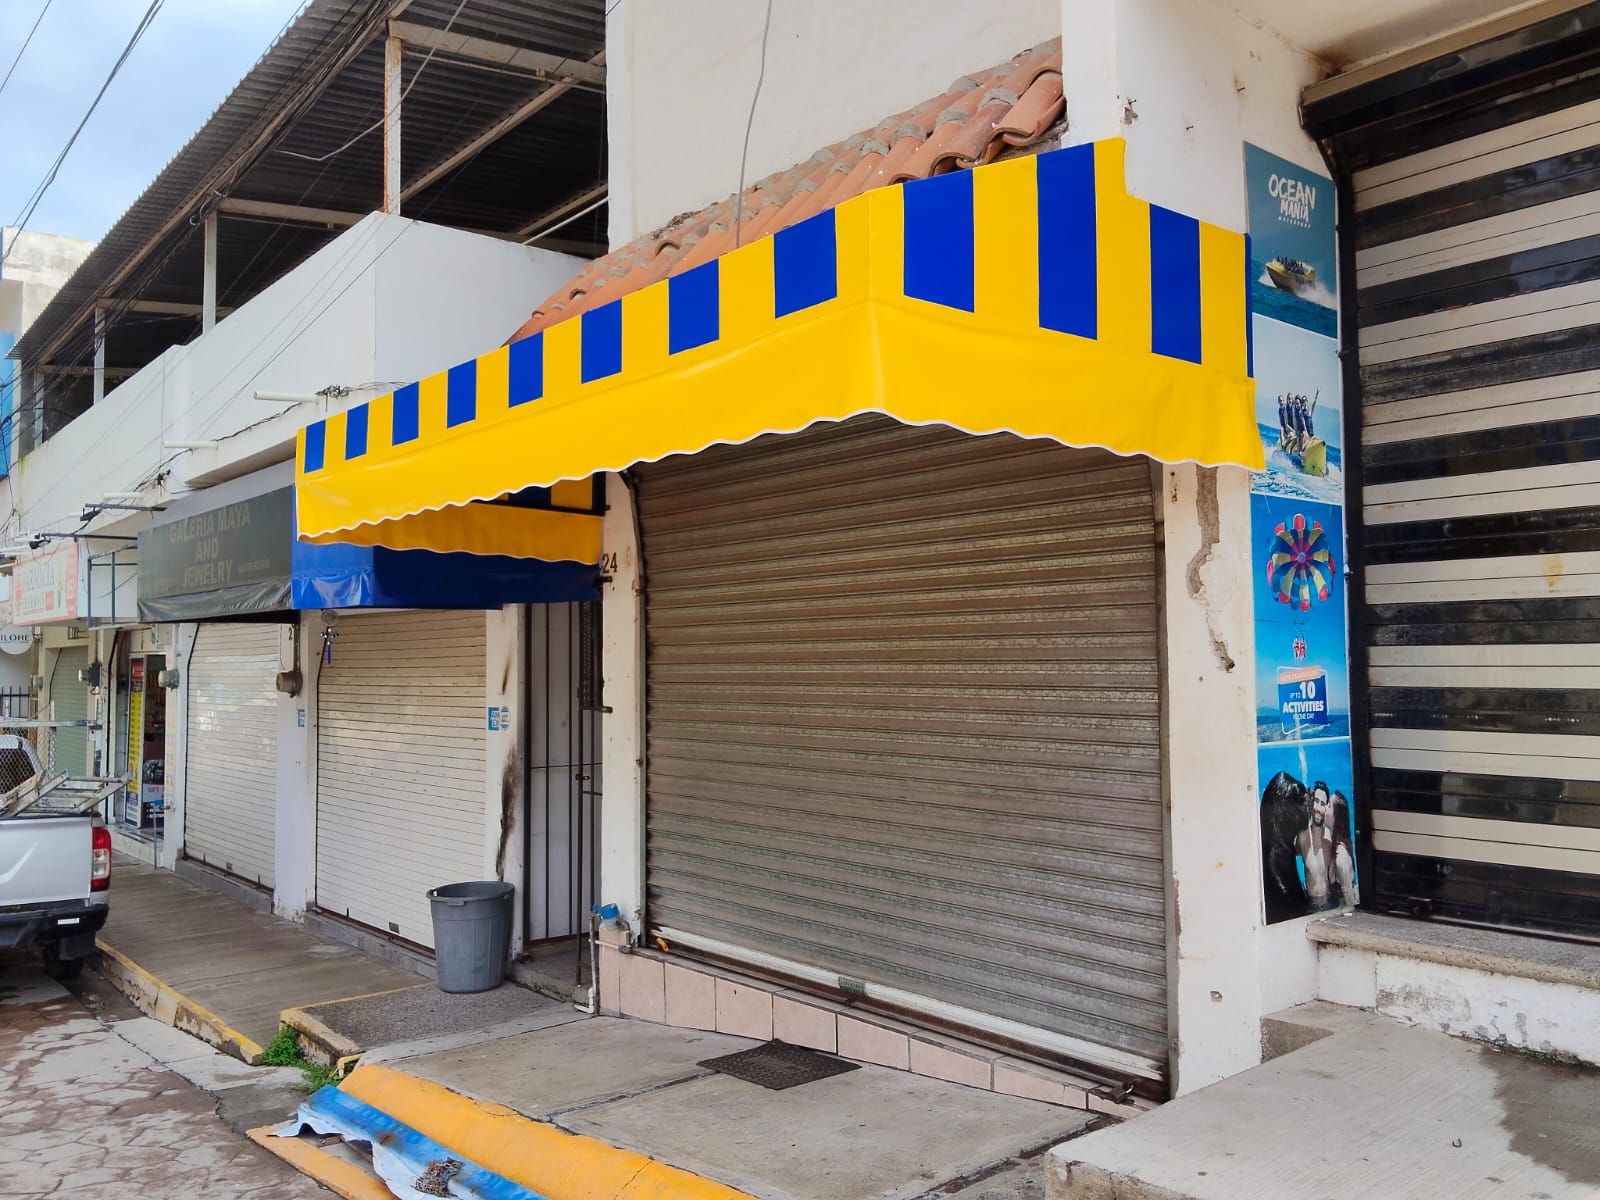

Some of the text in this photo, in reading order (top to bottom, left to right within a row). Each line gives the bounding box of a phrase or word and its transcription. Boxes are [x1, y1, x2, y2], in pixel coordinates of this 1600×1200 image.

[1269, 174, 1315, 209] OCEAN
[217, 503, 251, 533] MAYA
[195, 538, 219, 562] AND
[183, 560, 233, 588] JEWELRY
[602, 552, 617, 573] 24
[1300, 681, 1316, 698] 10
[1283, 701, 1324, 712] ACTIVITIES
